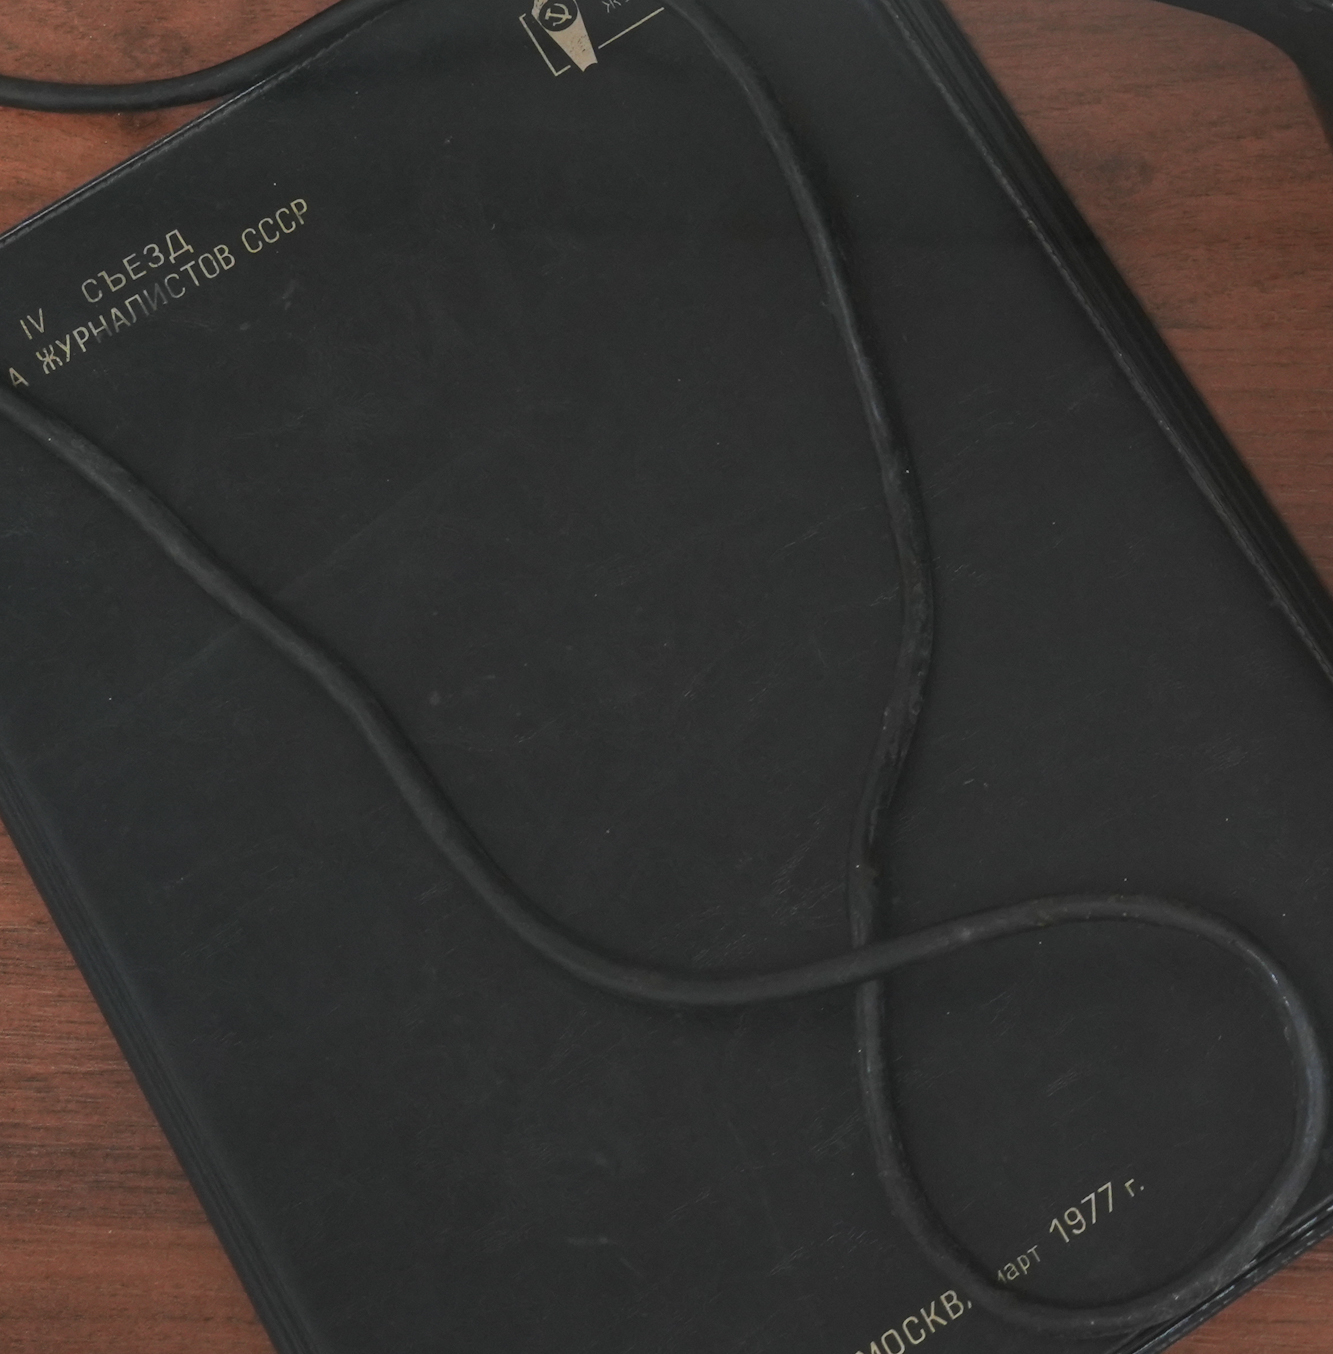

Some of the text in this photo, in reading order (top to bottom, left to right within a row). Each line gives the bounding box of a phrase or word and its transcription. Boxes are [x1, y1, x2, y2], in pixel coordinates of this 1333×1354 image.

[35, 197, 310, 375] ЖУРНАЛИСТОВ СССР
[81, 228, 195, 304] СЪЕЗД
[1049, 1181, 1115, 1244] 1977
[855, 1289, 973, 1354] МОСКВ
